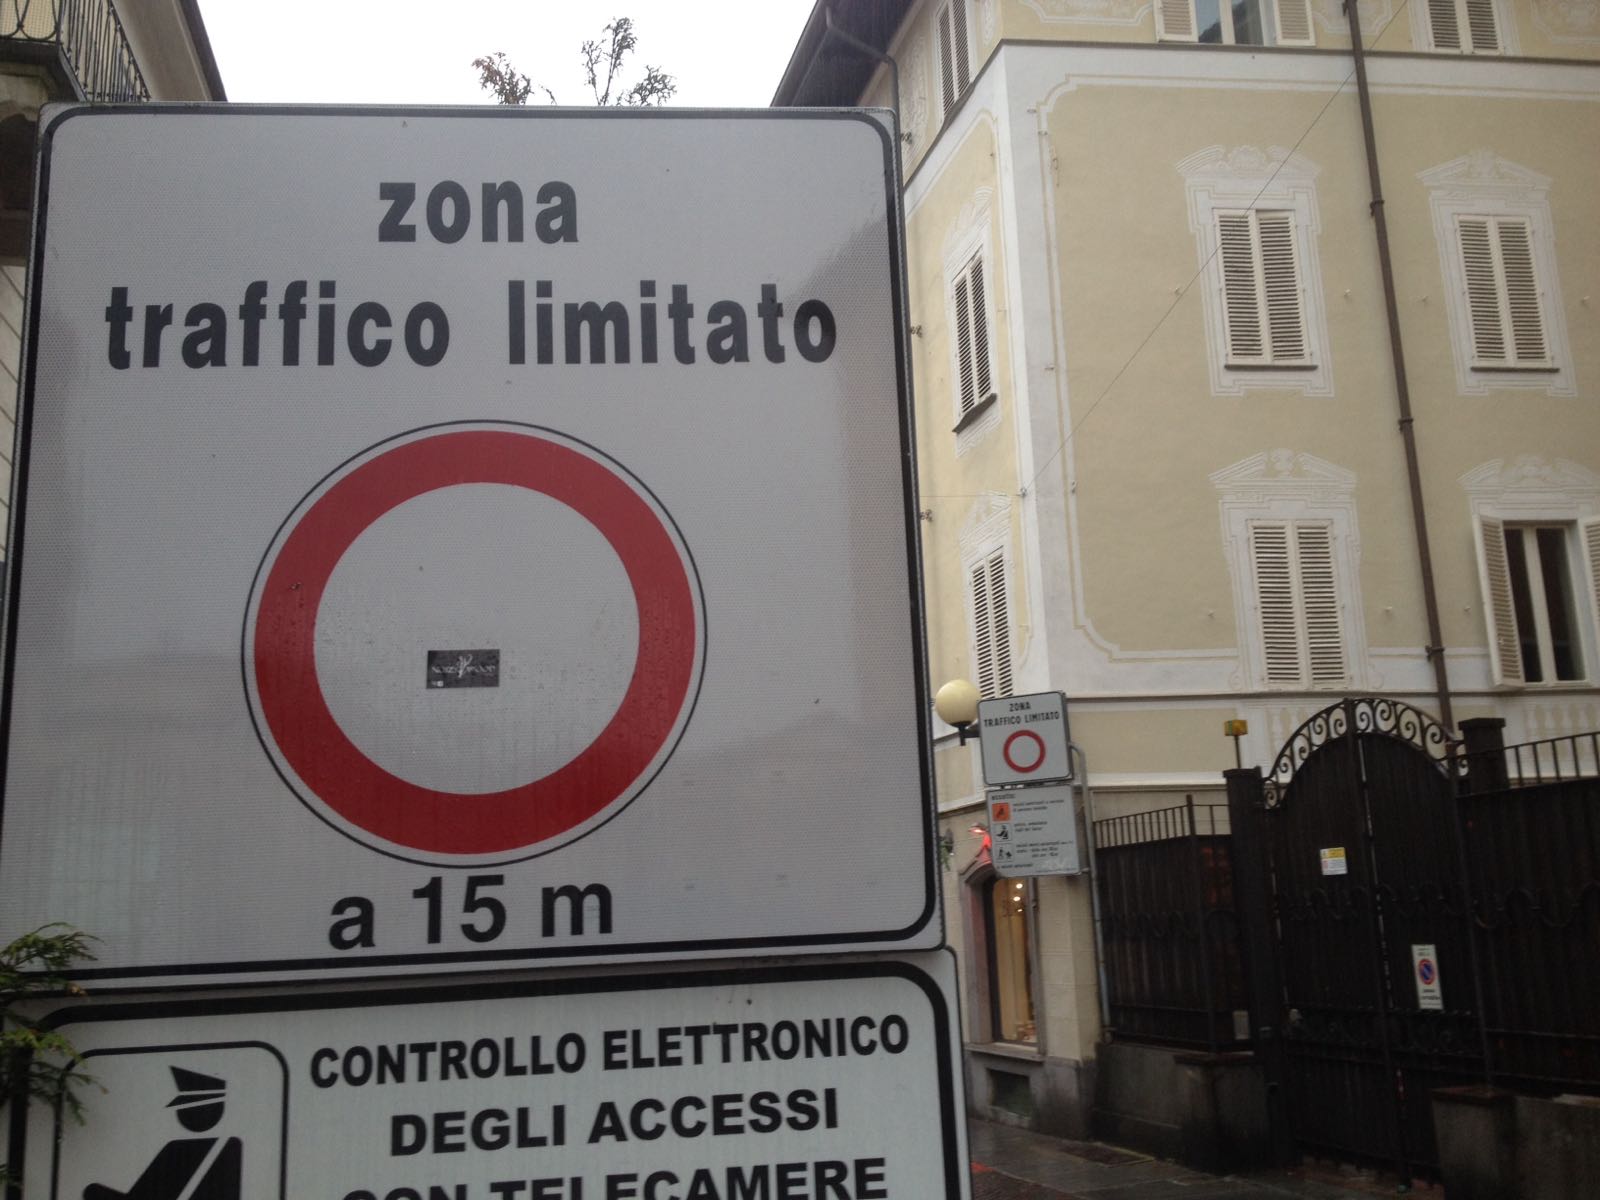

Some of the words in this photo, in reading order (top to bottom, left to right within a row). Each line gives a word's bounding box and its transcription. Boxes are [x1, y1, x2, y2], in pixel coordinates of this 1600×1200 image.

[379, 181, 578, 244] zona
[105, 280, 449, 370] traffico
[509, 280, 836, 364] limitato
[983, 715, 1021, 727] TRAFFICO
[1024, 711, 1060, 723] LIMITATO
[1008, 701, 1031, 712] ZONA
[329, 897, 375, 950] a
[413, 875, 506, 944] 15
[542, 884, 612, 937] m
[310, 1033, 586, 1088] CONTROLLO
[604, 1014, 908, 1070] ELETTRONICO
[391, 1105, 565, 1156] DEGLI
[588, 1088, 837, 1143] ACCESSI
